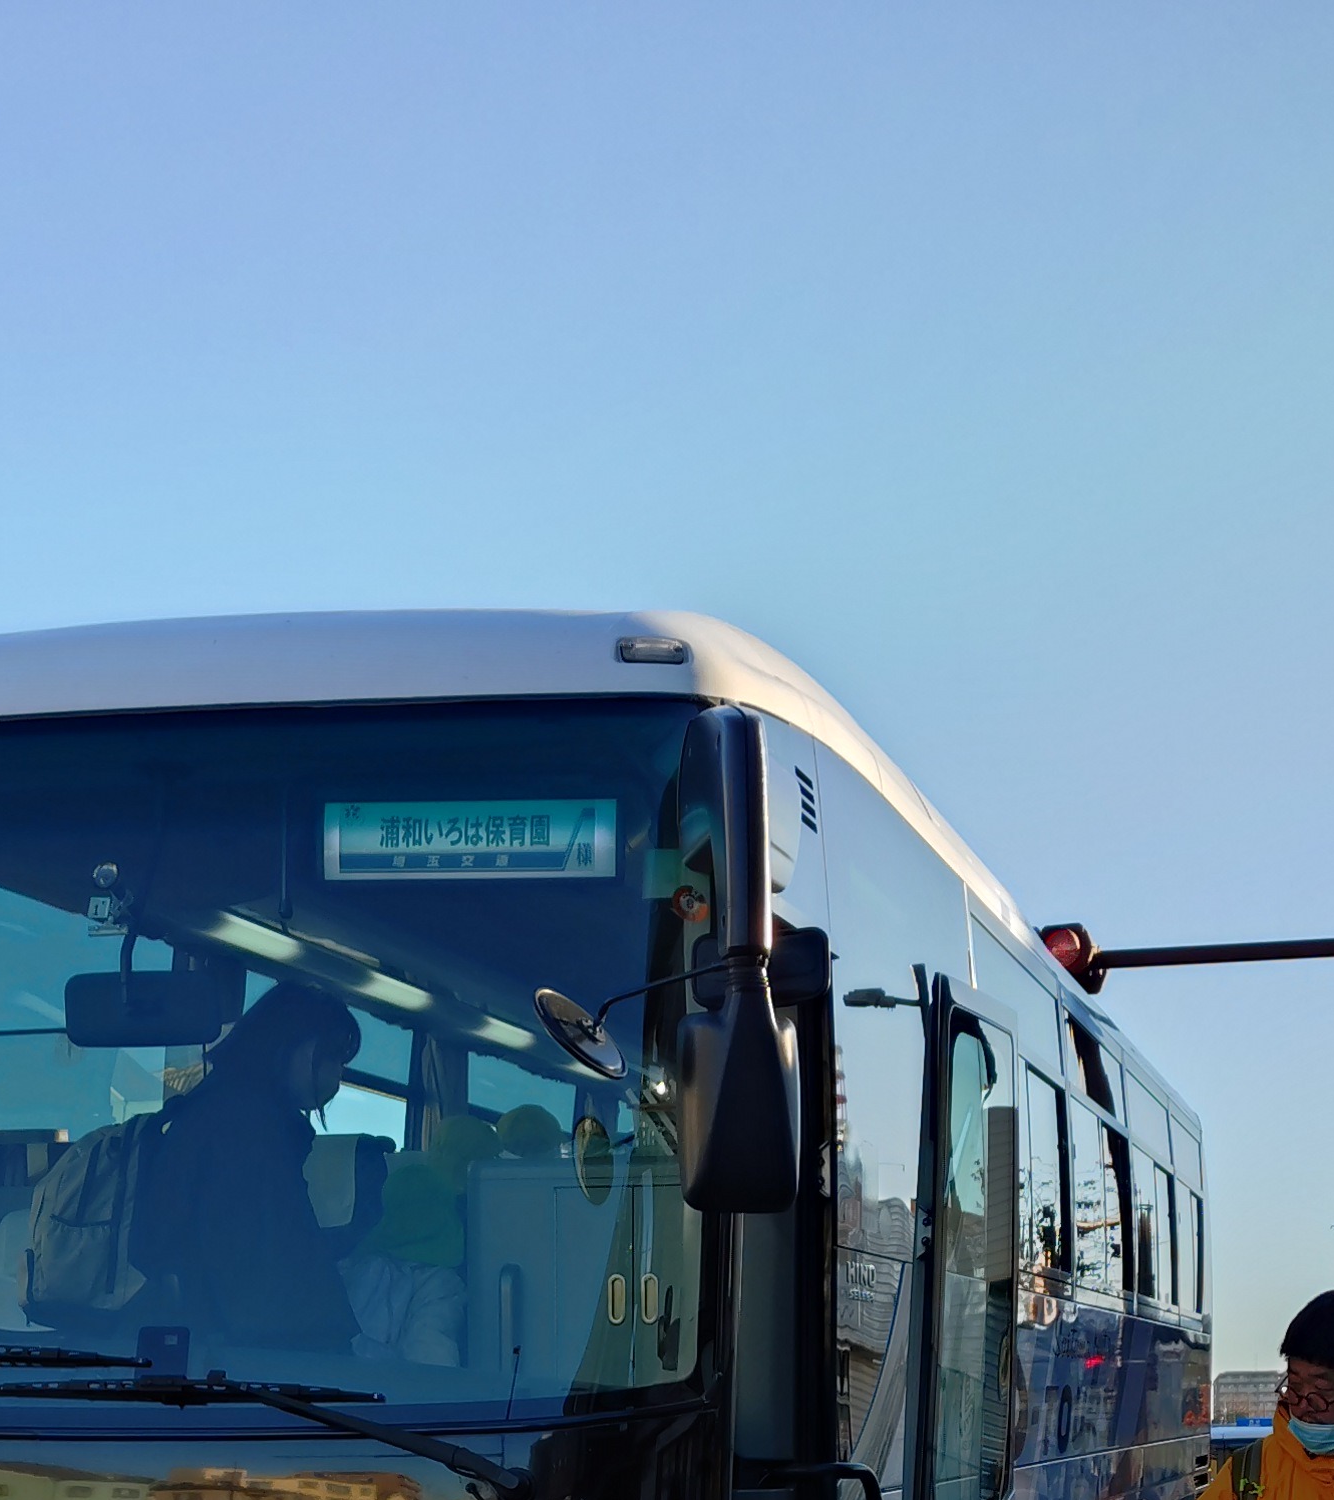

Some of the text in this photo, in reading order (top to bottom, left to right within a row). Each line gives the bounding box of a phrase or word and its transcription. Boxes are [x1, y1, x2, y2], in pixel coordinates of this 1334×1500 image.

[379, 814, 551, 848] 浦和いろは保育園
